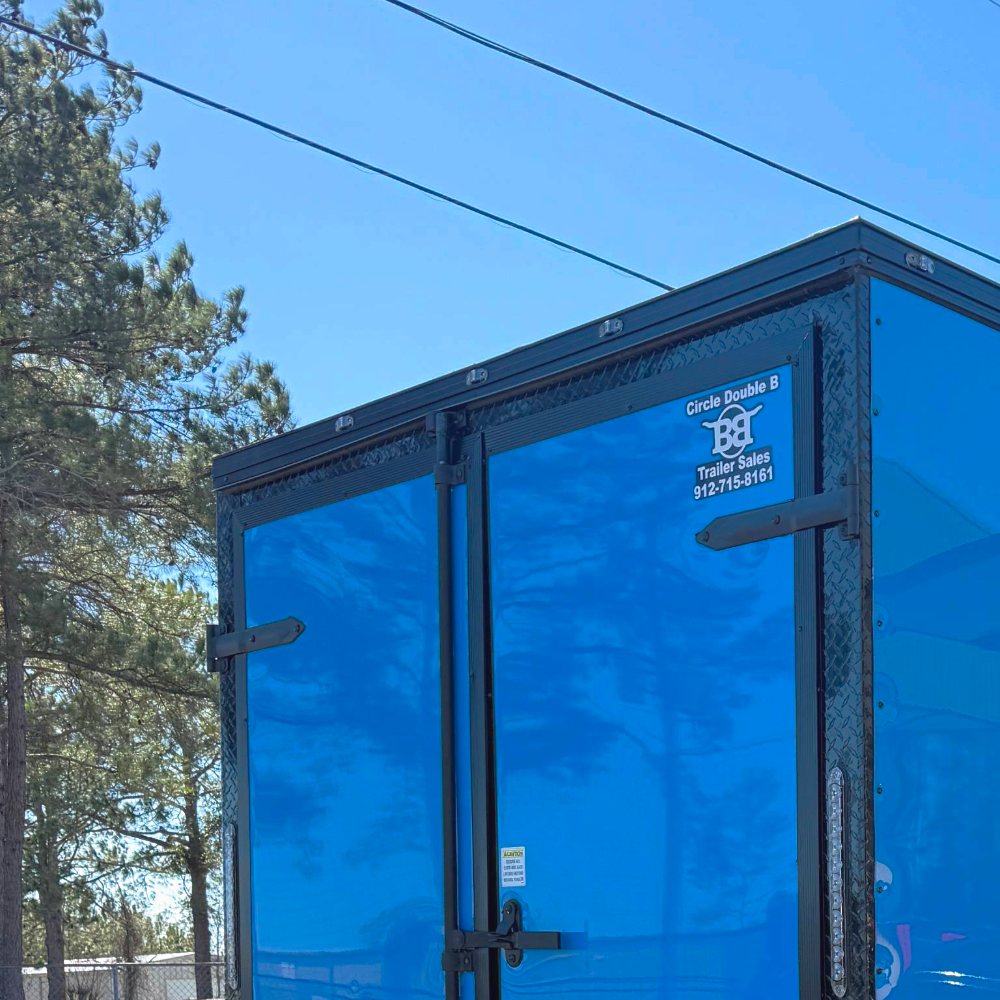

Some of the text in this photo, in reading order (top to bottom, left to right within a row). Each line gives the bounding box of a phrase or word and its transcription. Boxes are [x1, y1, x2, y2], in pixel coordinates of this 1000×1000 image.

[686, 374, 779, 416] Circle Double B
[694, 465, 773, 500] 912-715-8161
[697, 451, 770, 480] Trailer Sales
